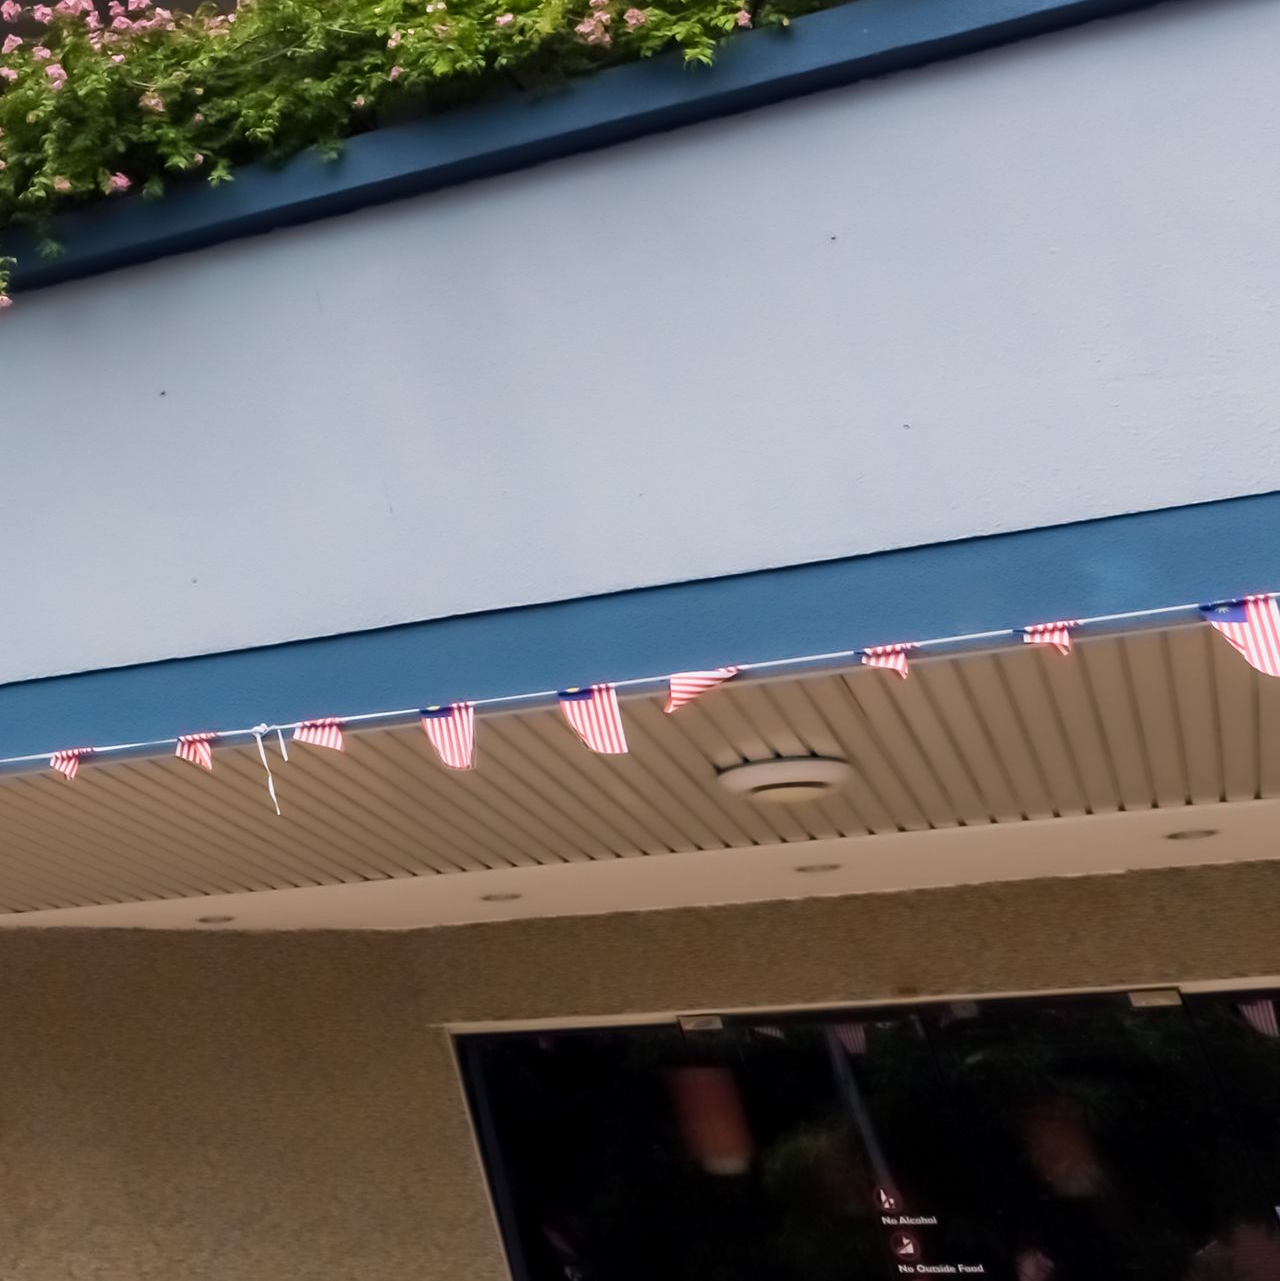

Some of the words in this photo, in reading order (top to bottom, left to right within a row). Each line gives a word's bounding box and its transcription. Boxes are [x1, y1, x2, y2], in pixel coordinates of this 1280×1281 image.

[881, 1216, 898, 1225] No
[899, 1216, 938, 1225] Alcohol
[898, 1264, 915, 1273] No
[916, 1264, 956, 1273] Outside
[957, 1264, 984, 1273] Food
